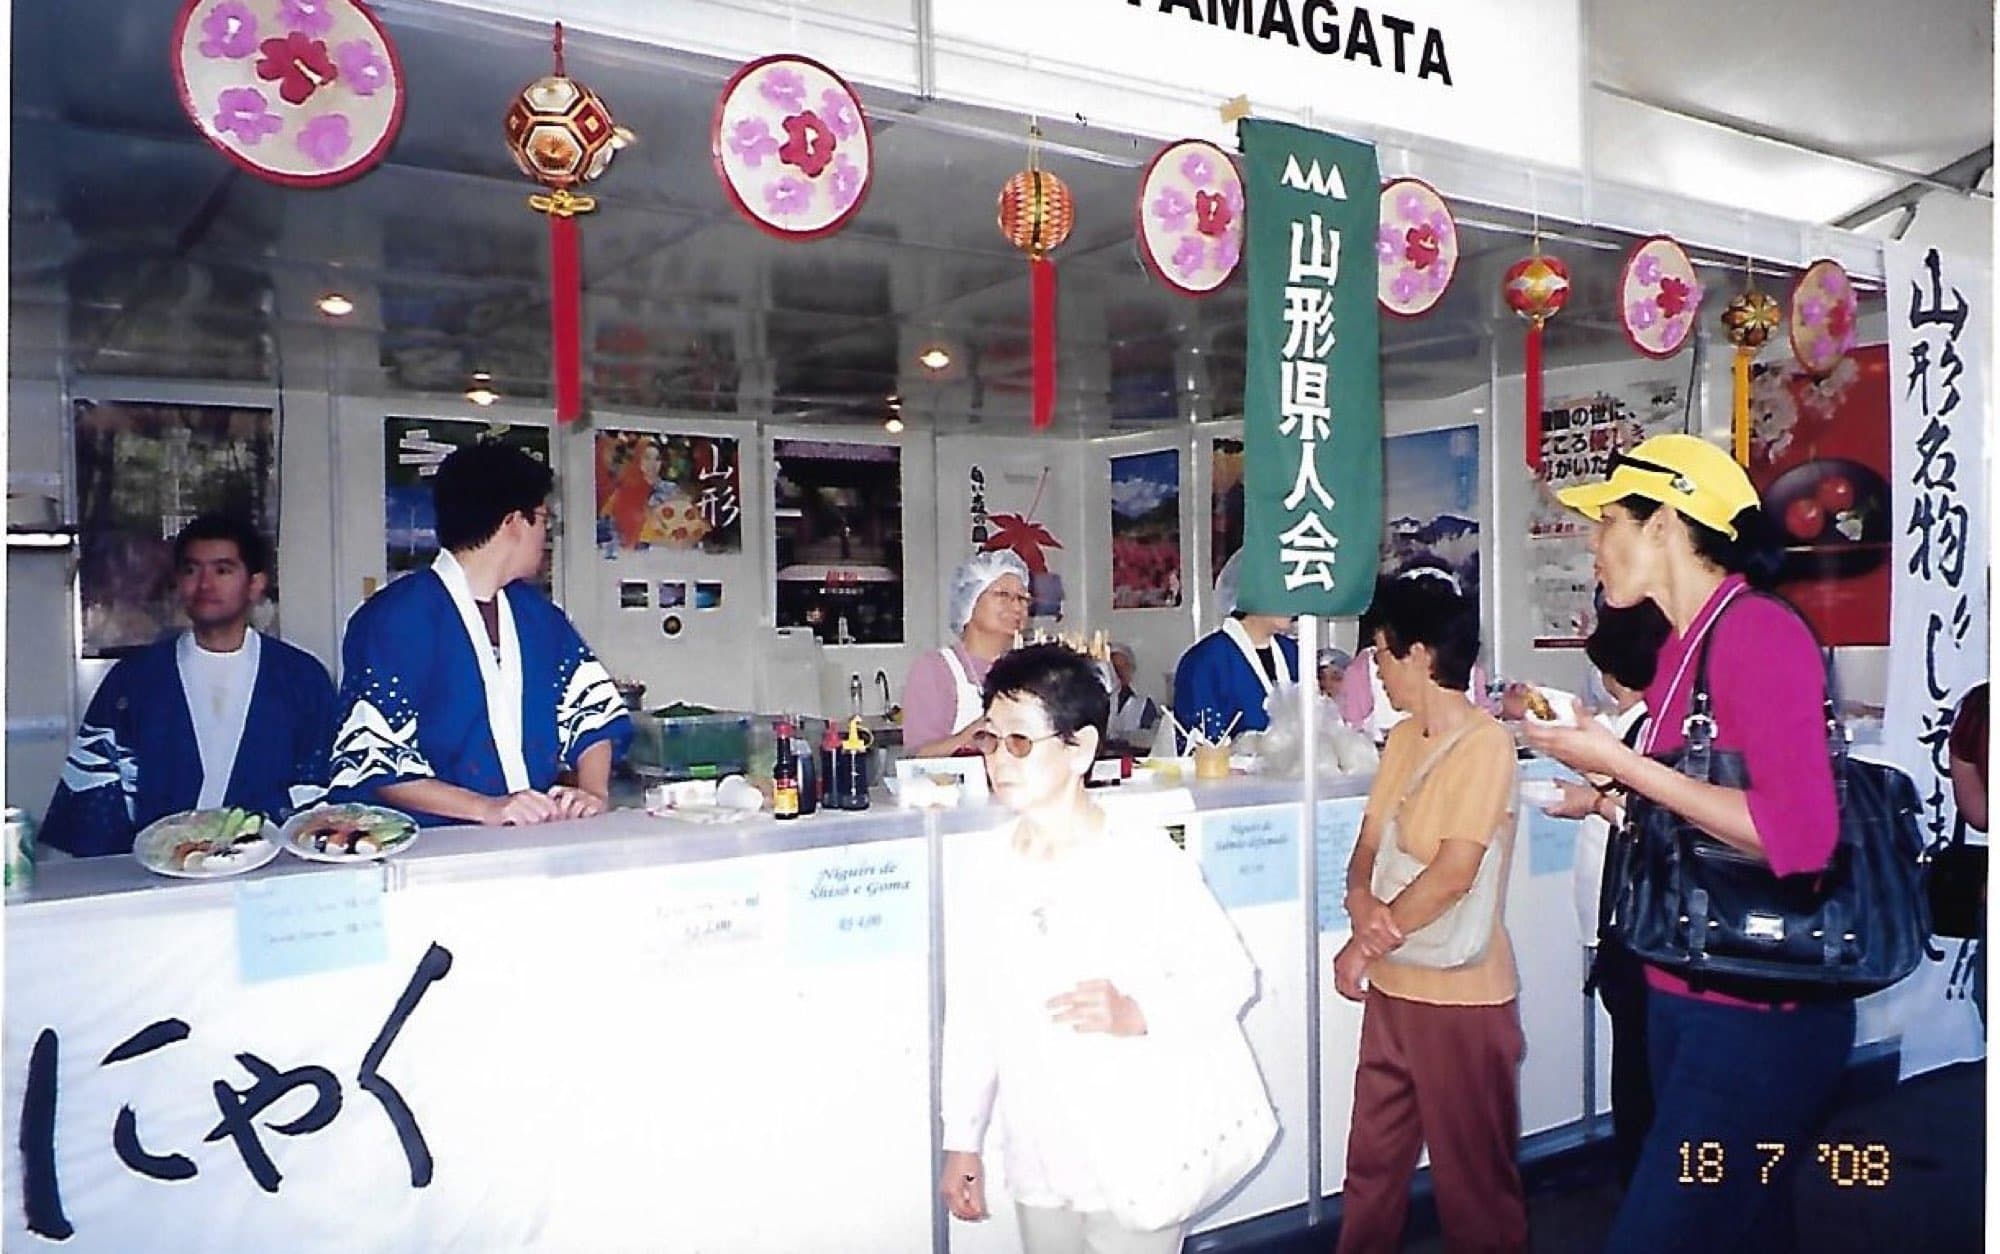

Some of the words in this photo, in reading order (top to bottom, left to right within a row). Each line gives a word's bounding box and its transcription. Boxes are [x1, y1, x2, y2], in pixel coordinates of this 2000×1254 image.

[1127, 0, 1453, 86] MAGATA
[698, 444, 740, 527] 山形
[1278, 213, 1341, 592] 山形県人会
[20, 941, 453, 1241] にゃく
